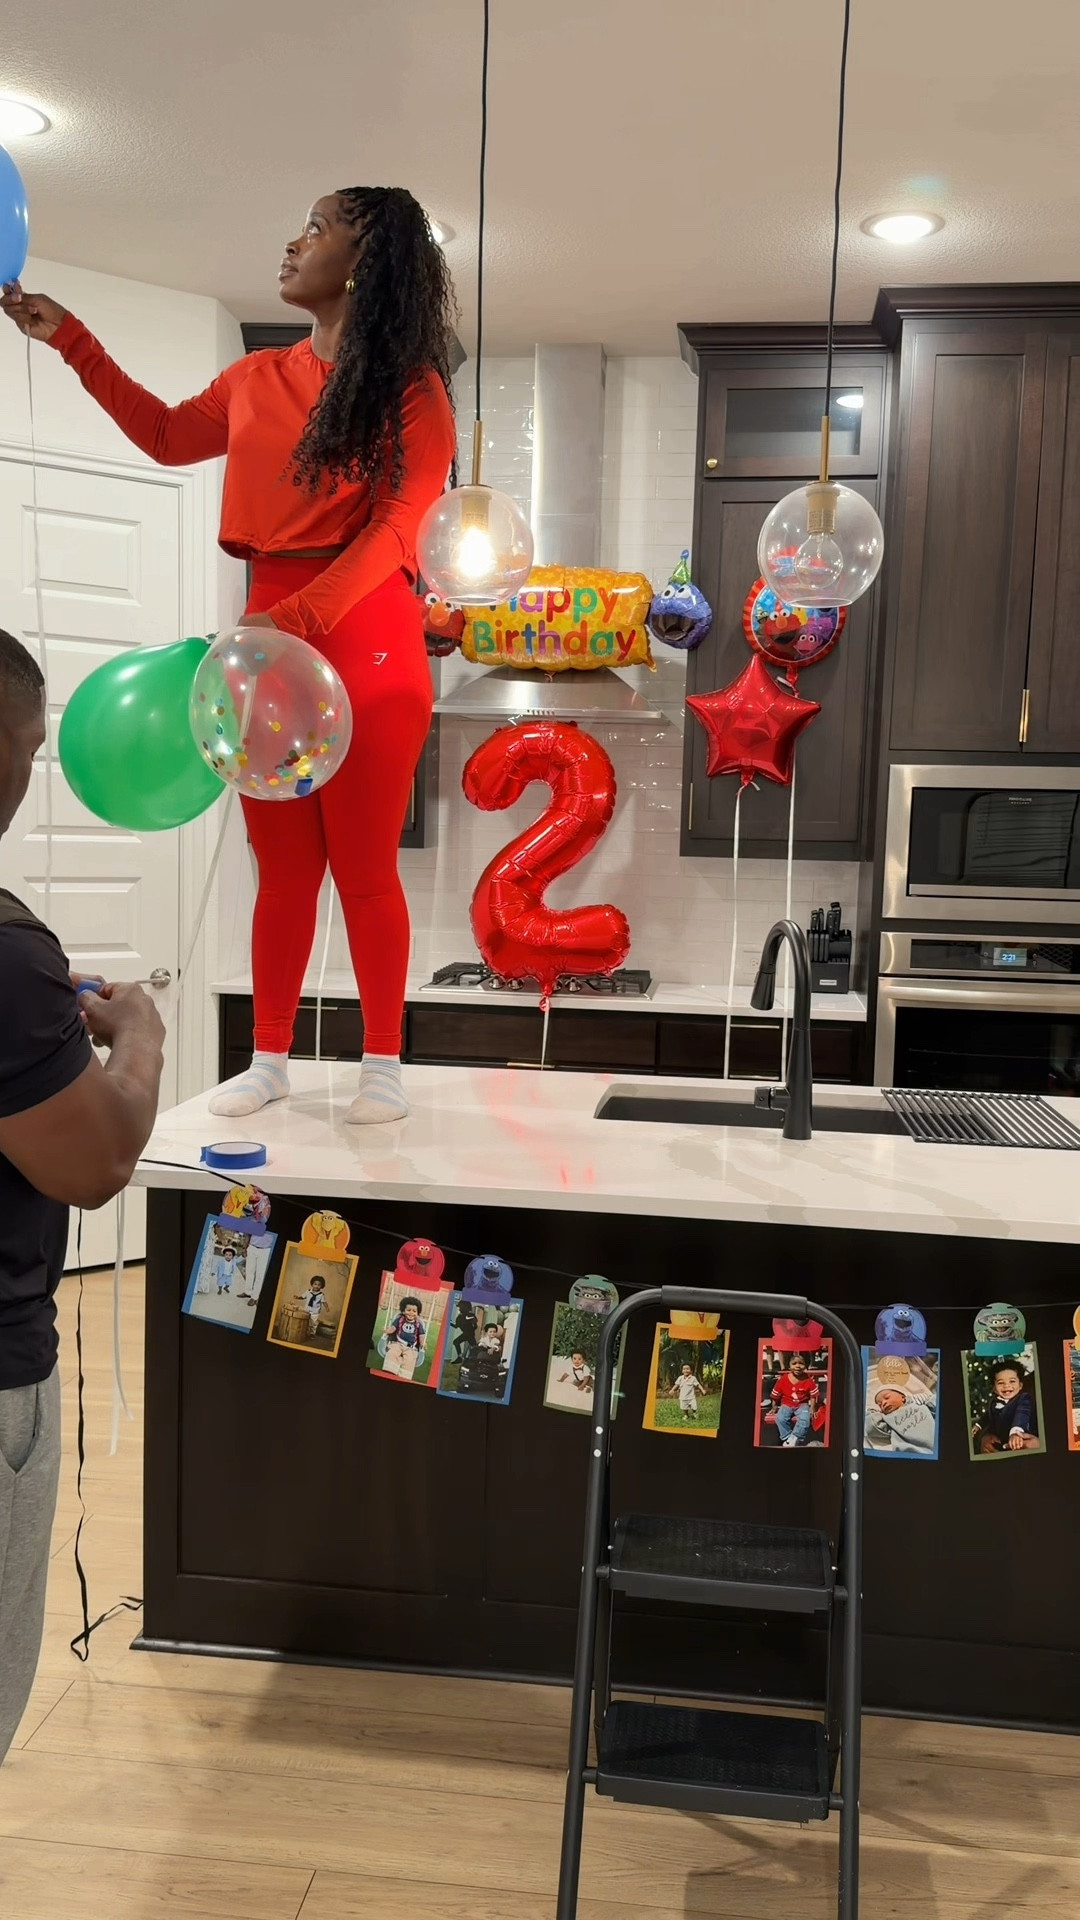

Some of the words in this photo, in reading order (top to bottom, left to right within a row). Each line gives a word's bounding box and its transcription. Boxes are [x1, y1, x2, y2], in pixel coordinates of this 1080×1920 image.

[489, 587, 619, 623] appy
[473, 619, 637, 661] Birthday
[462, 721, 631, 980] 2
